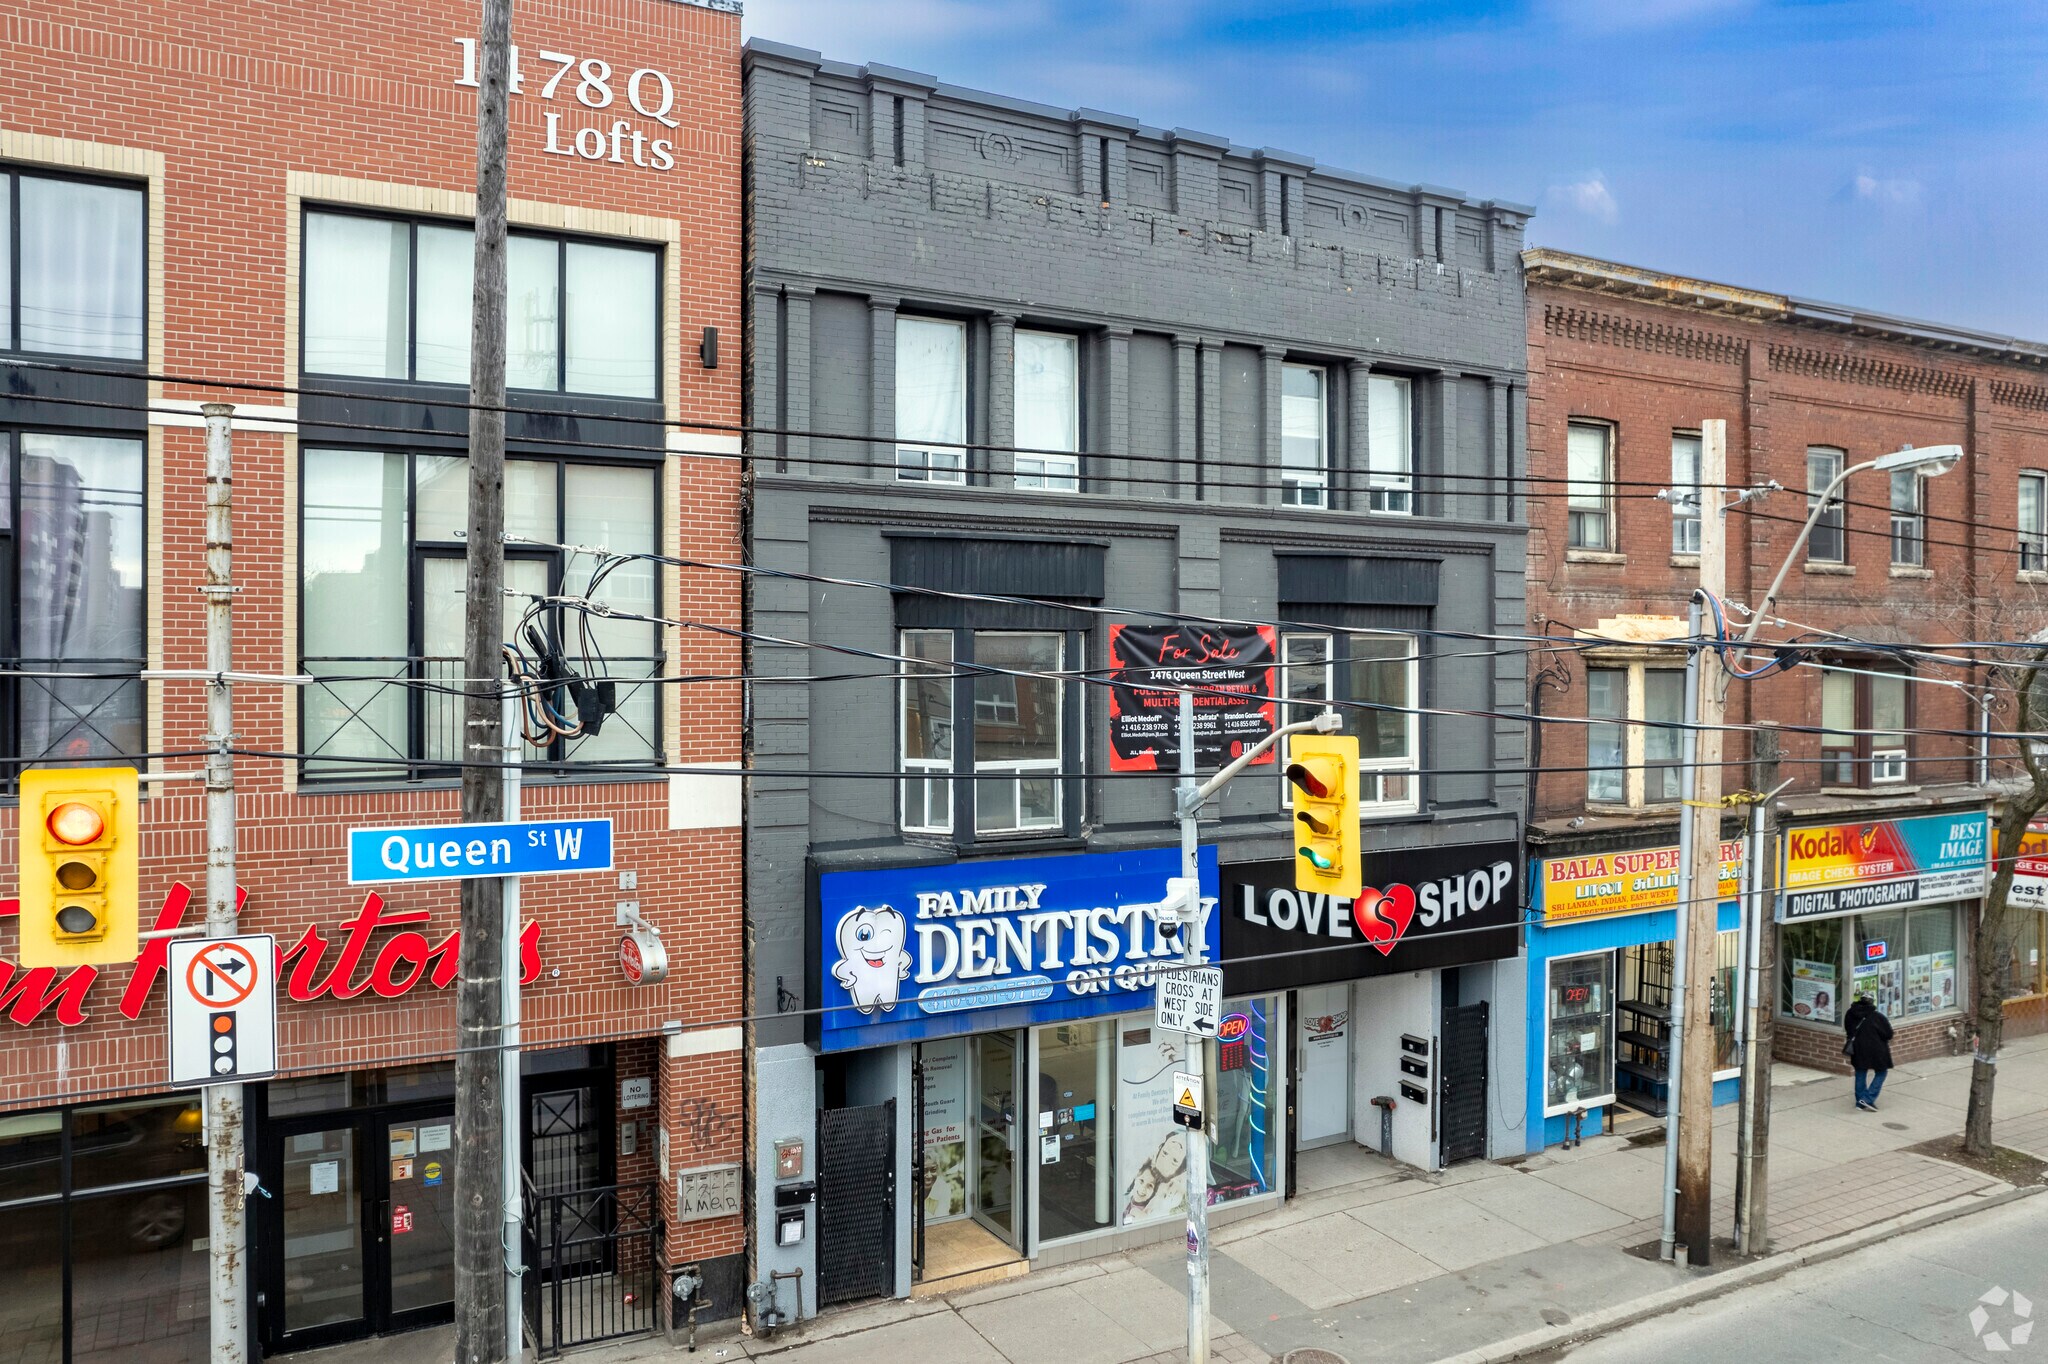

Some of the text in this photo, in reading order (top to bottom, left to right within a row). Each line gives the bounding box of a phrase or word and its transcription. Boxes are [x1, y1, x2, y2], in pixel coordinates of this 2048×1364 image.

[628, 68, 680, 128] Q
[543, 112, 675, 170] Lofts
[1158, 634, 1241, 663] For Sale
[1150, 669, 1245, 681] 1476 Queen Street West
[1227, 685, 1251, 693] RETAIL
[1252, 685, 1257, 693] &
[1143, 696, 1227, 707] MULTI-RDENTIAL
[1949, 821, 1984, 840] BEST
[381, 828, 583, 873] Queen St W
[1790, 831, 1854, 860] Kodak
[1939, 839, 1983, 859] IMAGE
[1551, 858, 1609, 882] BALA
[1789, 862, 1894, 882] IMAGE CHECK SYSTEM
[1931, 861, 1954, 869] IMAGE
[1240, 884, 1353, 938] LOVE
[1418, 861, 1513, 928] SHOP
[1793, 882, 1915, 915] DIGITAL PHOTOGRAPHY
[2012, 884, 2046, 897] est
[916, 884, 1048, 919] FAMILY
[1551, 903, 1565, 912] SRI
[1630, 892, 1648, 902] EAST
[1650, 890, 1670, 899] WEST
[1066, 966, 1110, 995] ON
[1160, 965, 1219, 987] PEDESTRIANS
[1165, 982, 1213, 1001] CROSS AT
[1164, 996, 1213, 1017] WEST SIDE
[1161, 1011, 1184, 1027] ONLY
[1218, 1018, 1246, 1038] OPEN
[623, 1093, 649, 1101] LOITERING
[925, 1108, 947, 1116] Grinding
[936, 1134, 960, 1143] Patients
